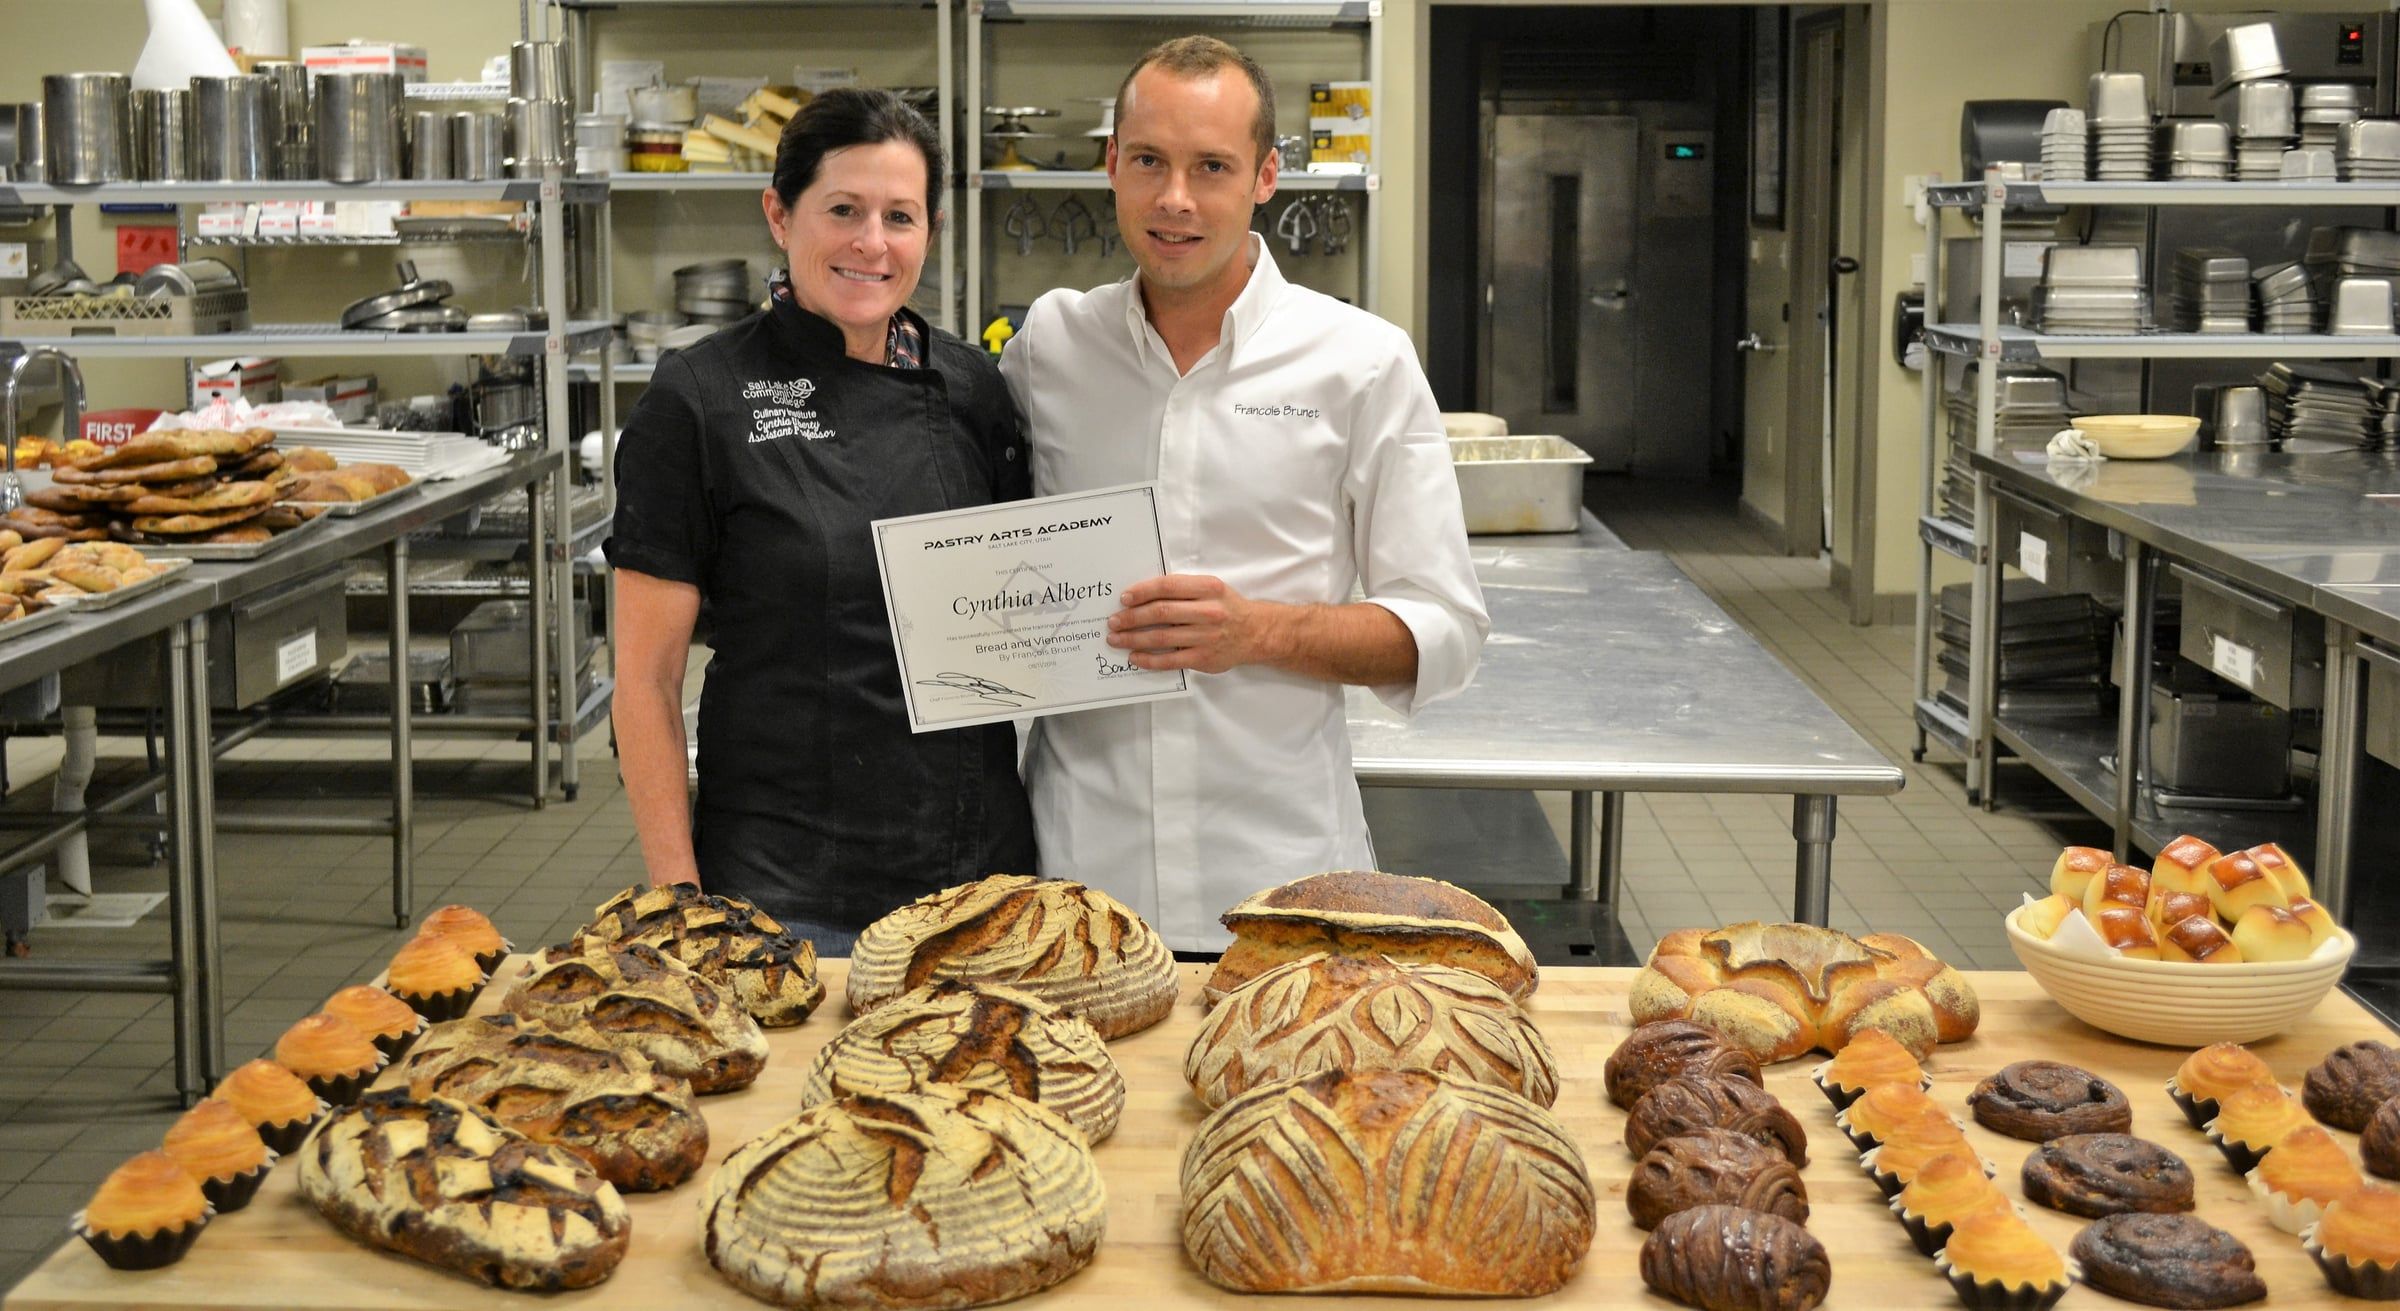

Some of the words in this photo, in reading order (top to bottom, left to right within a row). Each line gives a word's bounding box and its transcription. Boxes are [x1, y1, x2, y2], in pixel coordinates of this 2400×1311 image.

[767, 380, 789, 391] Lake
[753, 408, 786, 419] Culinary
[1234, 404, 1280, 416] Francois
[1283, 405, 1320, 418] Brunet
[87, 421, 136, 443] FIRST
[748, 428, 793, 443] Assistant
[794, 425, 836, 441] Professor
[756, 417, 792, 433] Cynthia
[924, 534, 983, 550] PASTRY
[989, 528, 1033, 542] ARTS
[1037, 516, 1113, 536] ACADEMY
[952, 590, 1034, 620] Cynthia
[1041, 580, 1113, 605] Alberts
[1032, 623, 1055, 631] training
[975, 641, 1008, 654] Bread
[1011, 638, 1032, 650] and
[1033, 630, 1101, 646] Viennoiserie
[999, 653, 1010, 662] By
[1012, 649, 1049, 661] François
[1051, 644, 1081, 655] Brunet
